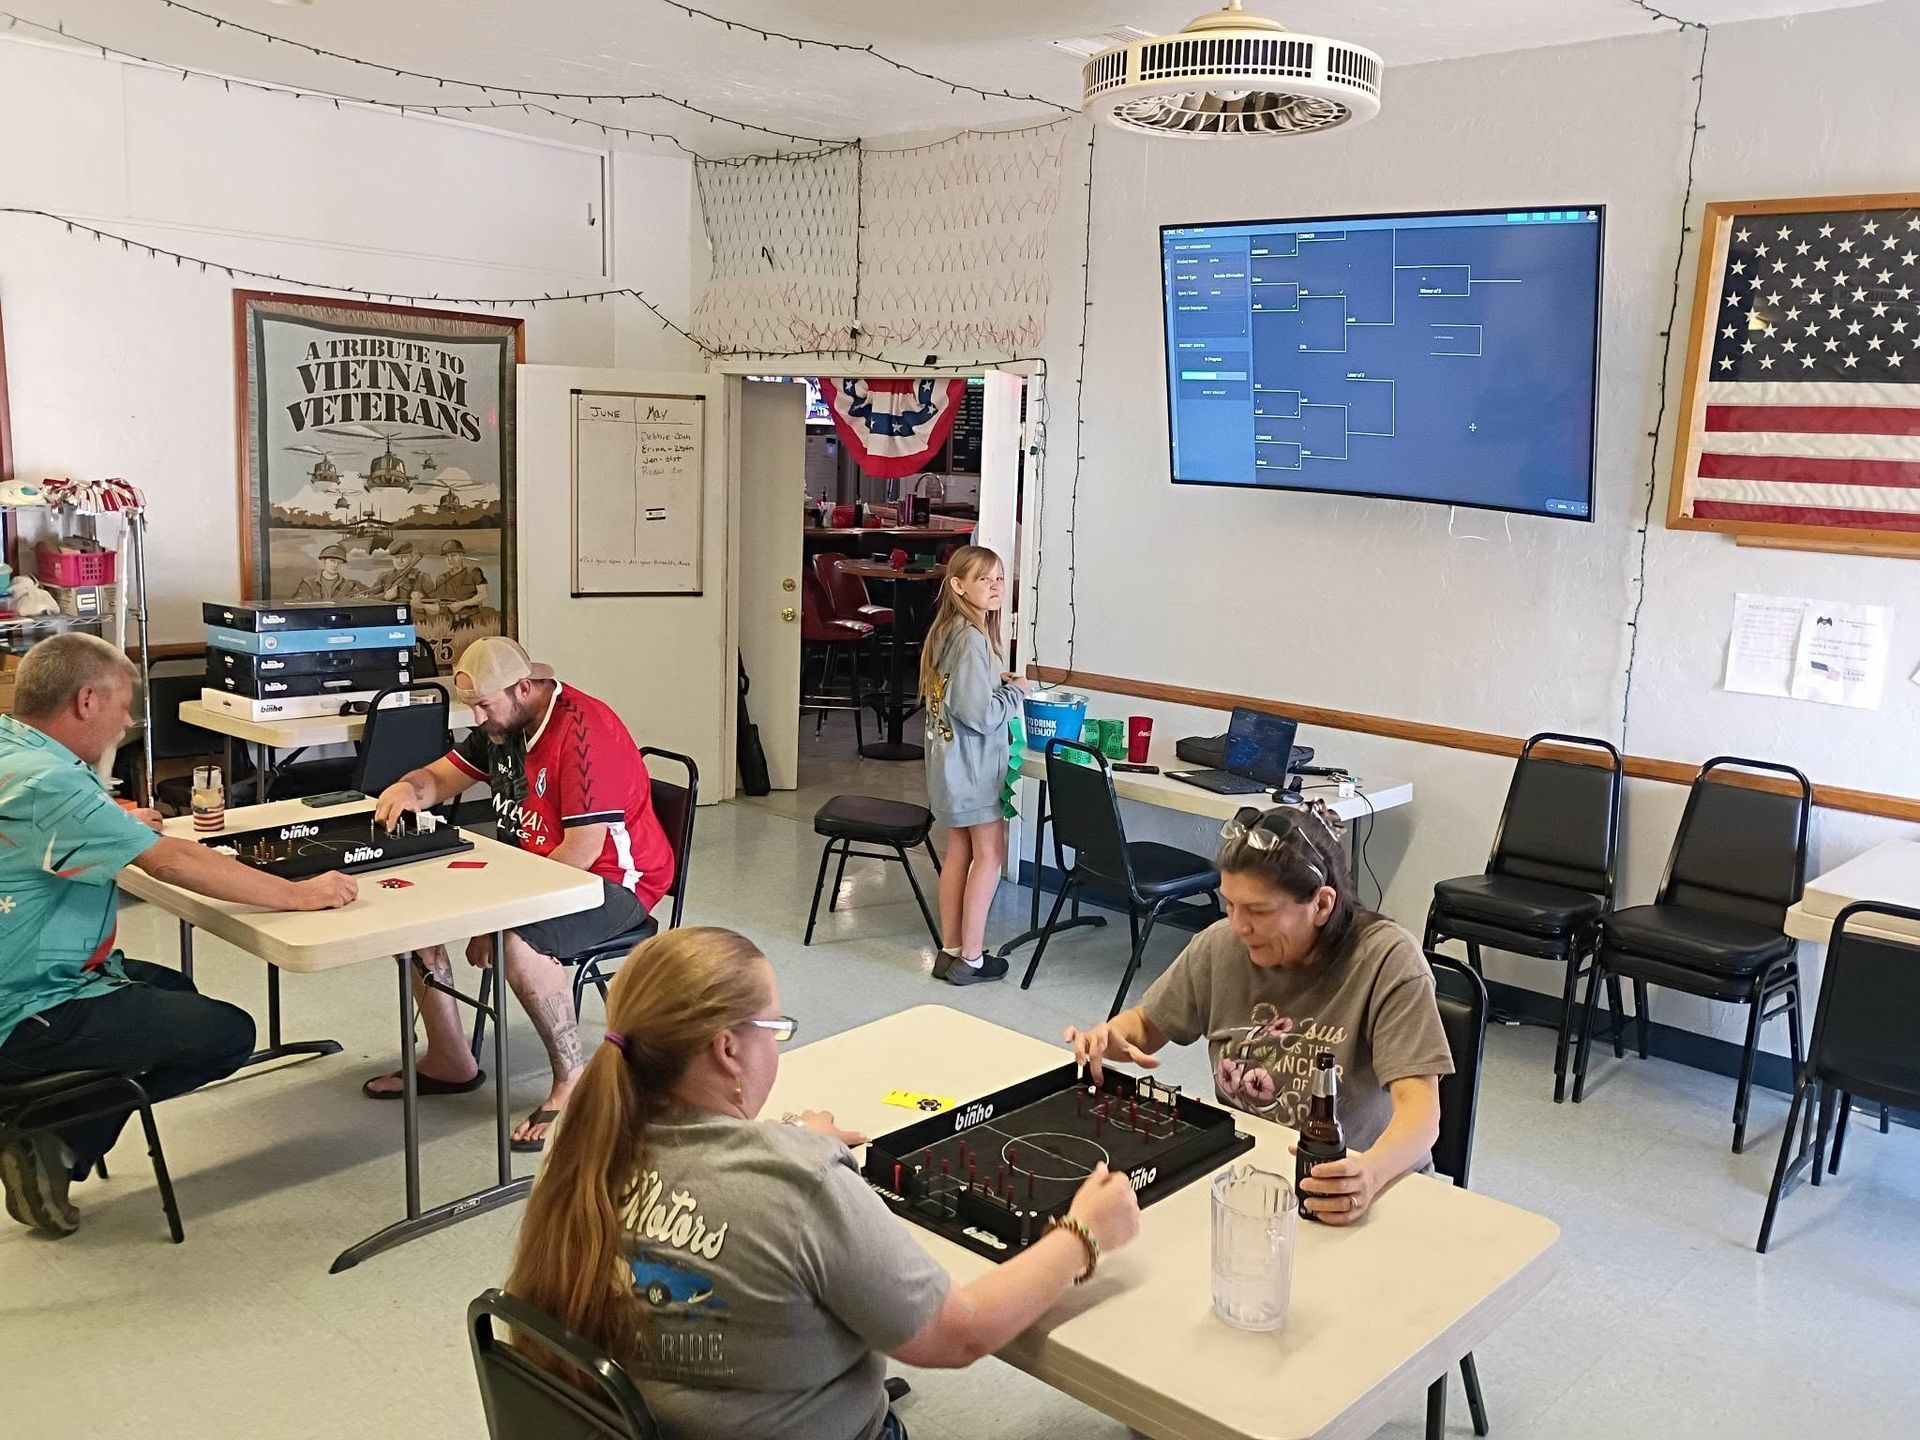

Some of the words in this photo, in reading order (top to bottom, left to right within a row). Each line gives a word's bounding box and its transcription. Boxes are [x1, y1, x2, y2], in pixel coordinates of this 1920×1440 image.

[305, 341, 322, 361] A
[326, 338, 431, 364] TRIBUTE
[436, 350, 465, 375] TO
[296, 359, 468, 407] VIETNAM
[286, 392, 482, 443] VETERANS
[589, 406, 621, 418] JUNE
[646, 405, 668, 421] May
[1034, 719, 1057, 729] DRINK
[1034, 728, 1057, 738] ENJOY
[1308, 1043, 1331, 1057] THE
[1272, 1055, 1344, 1083] ANCHR
[1292, 1077, 1309, 1091] OF
[619, 1170, 728, 1260] Motors
